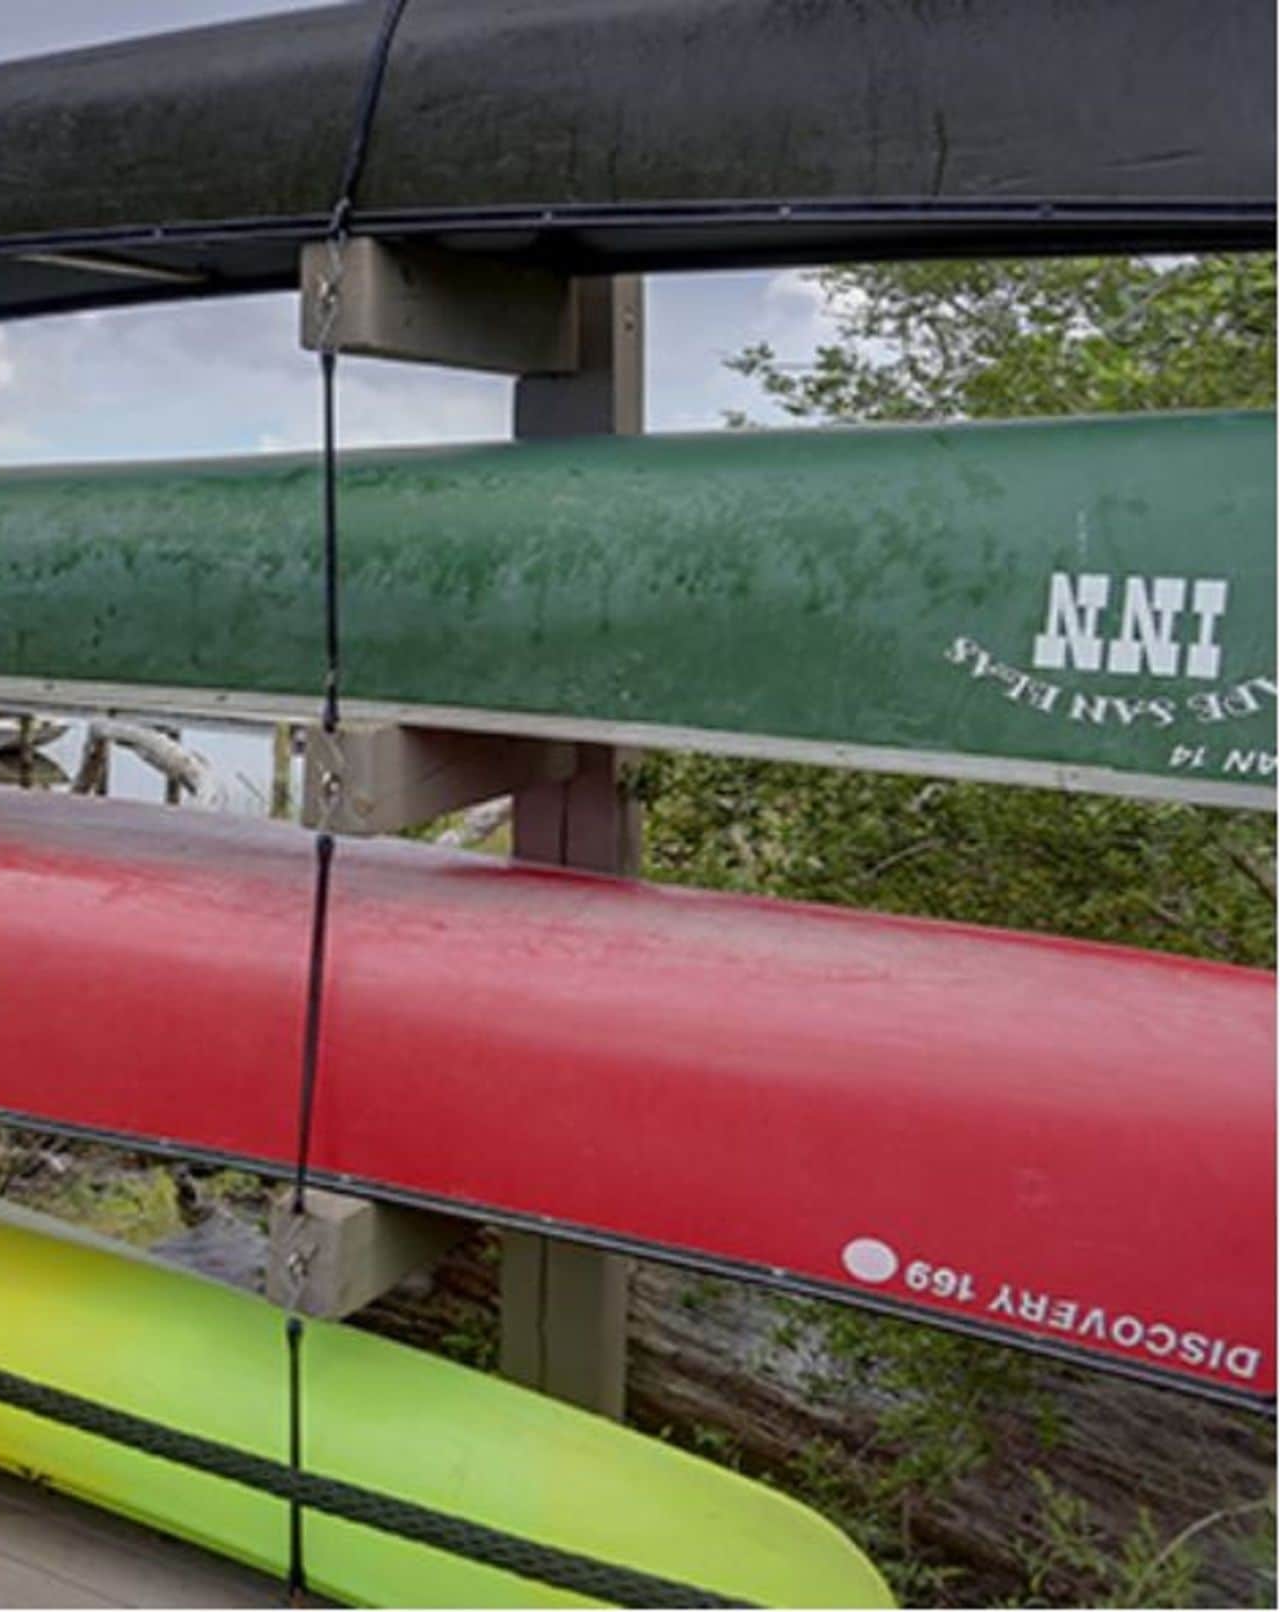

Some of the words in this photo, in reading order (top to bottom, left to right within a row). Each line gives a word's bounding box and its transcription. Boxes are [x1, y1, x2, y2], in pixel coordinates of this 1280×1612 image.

[1032, 572, 1229, 680] INN
[1070, 693, 1178, 727] SAN
[1169, 744, 1207, 768] 14
[904, 1259, 975, 1302] 169
[989, 1284, 1262, 1380] DISCOVERY
